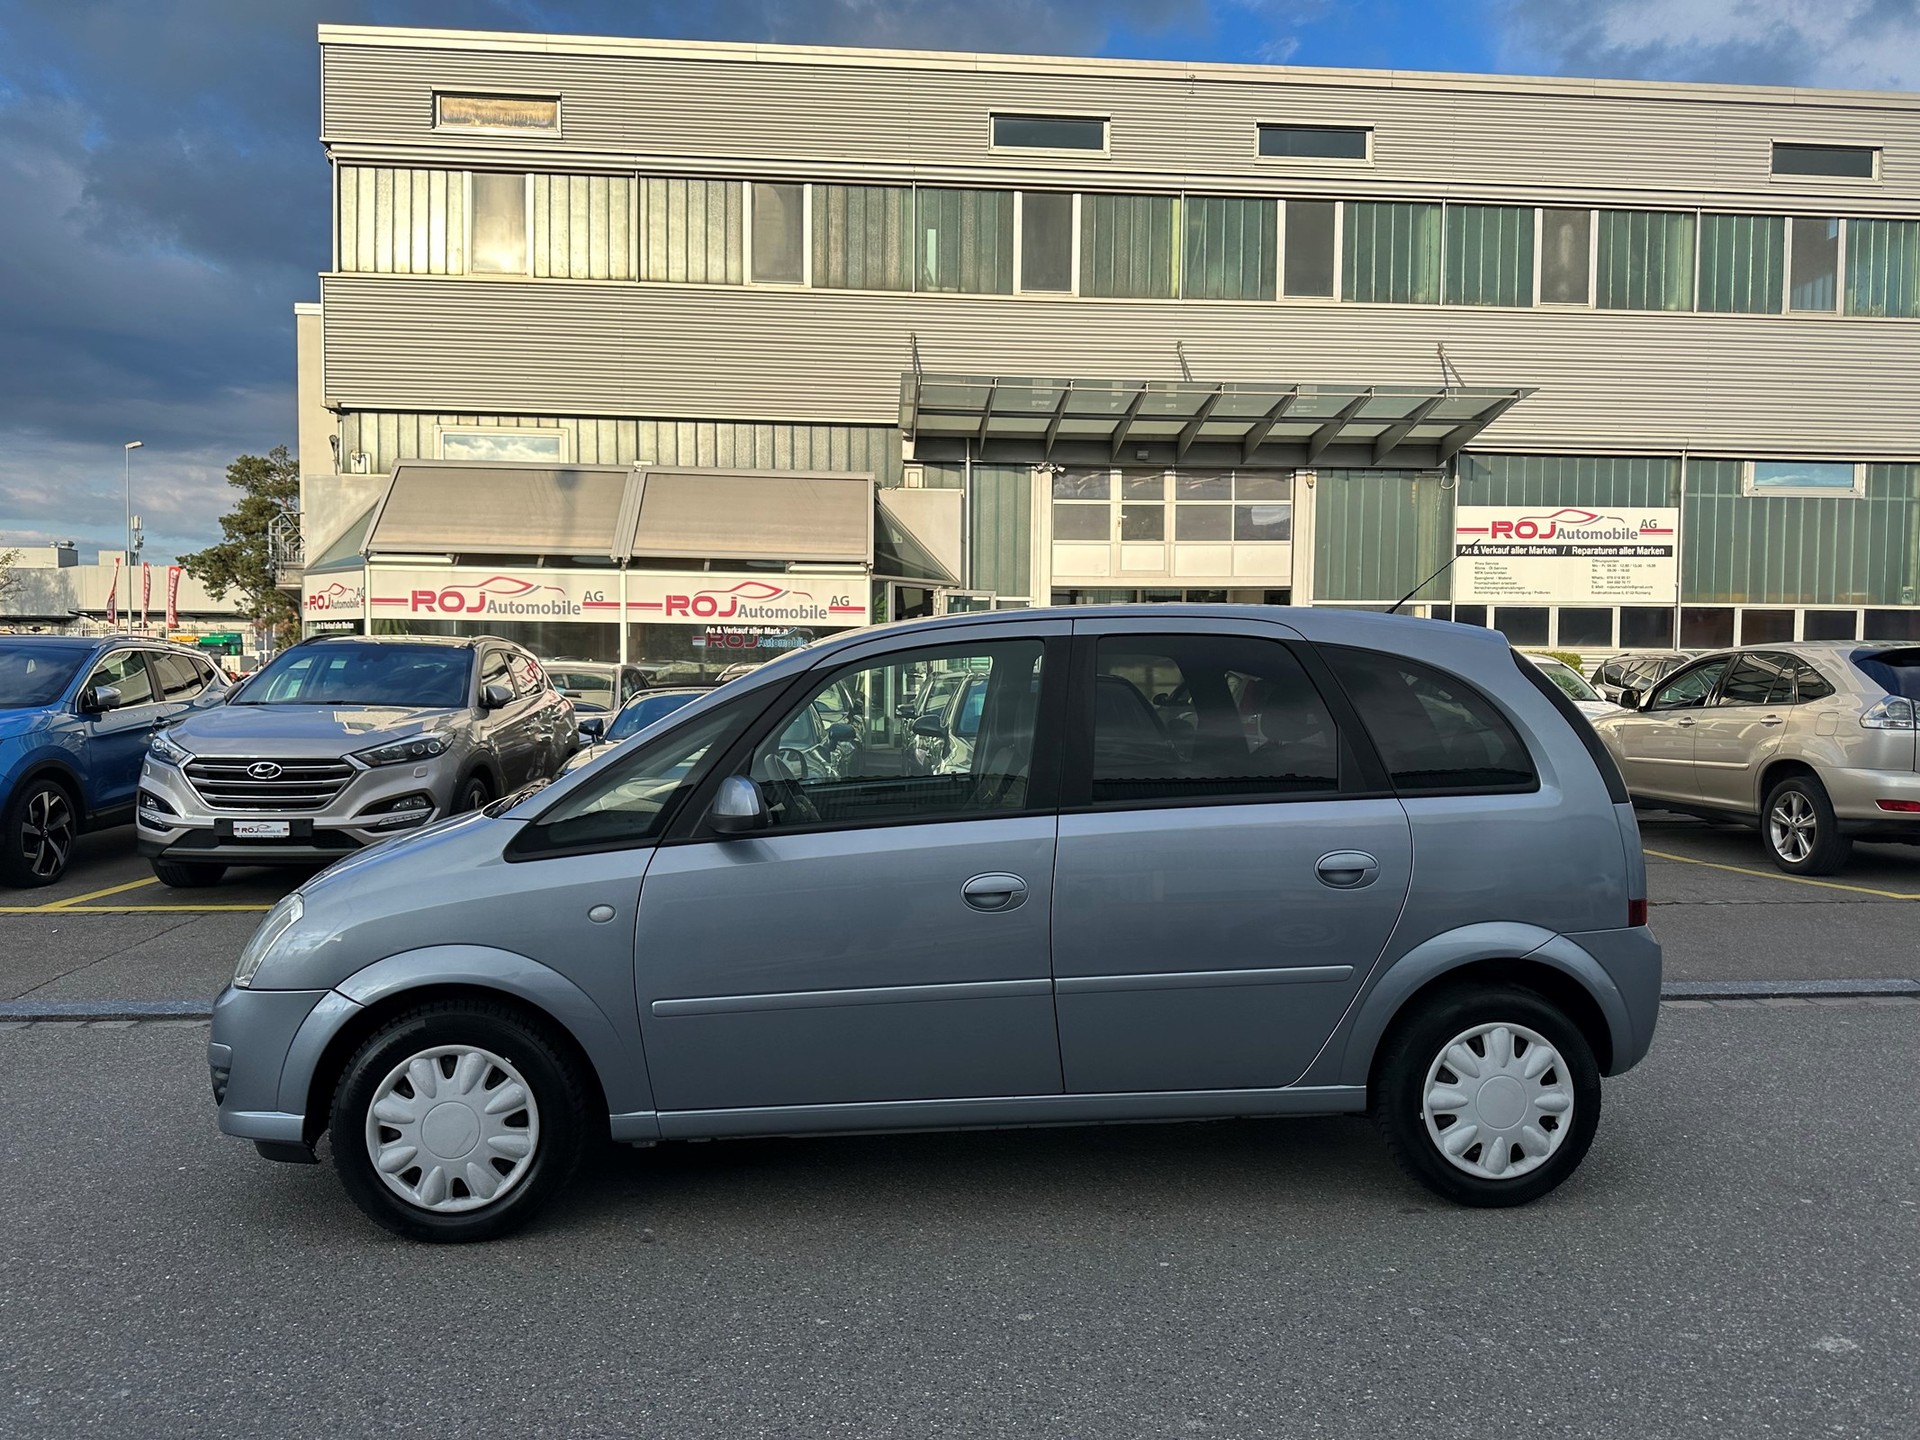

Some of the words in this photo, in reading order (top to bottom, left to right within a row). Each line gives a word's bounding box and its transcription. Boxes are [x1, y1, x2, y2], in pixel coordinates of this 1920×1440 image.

[1491, 521, 1557, 539] ROJ
[1556, 527, 1639, 540] Automobile
[1641, 519, 1657, 529] AG
[1461, 546, 1472, 554] An
[1473, 546, 1479, 554] &
[1480, 546, 1510, 554] Verkauf
[1510, 546, 1527, 554] aller
[1528, 546, 1557, 555] Marken
[1572, 546, 1618, 556] Reparaturen
[1619, 547, 1636, 555] aller
[1636, 547, 1665, 555] Marken
[309, 594, 331, 610] ROJ
[411, 590, 486, 613] ROJ
[486, 600, 582, 615] Automobile
[583, 590, 604, 602] AG
[666, 595, 737, 617] ROJ
[737, 604, 828, 620] Automobile
[830, 595, 850, 607] AG
[705, 626, 716, 634] An
[723, 626, 749, 634] Verkauf
[749, 626, 763, 635] aller
[764, 627, 789, 635] Markn
[706, 633, 759, 648] ROJ
